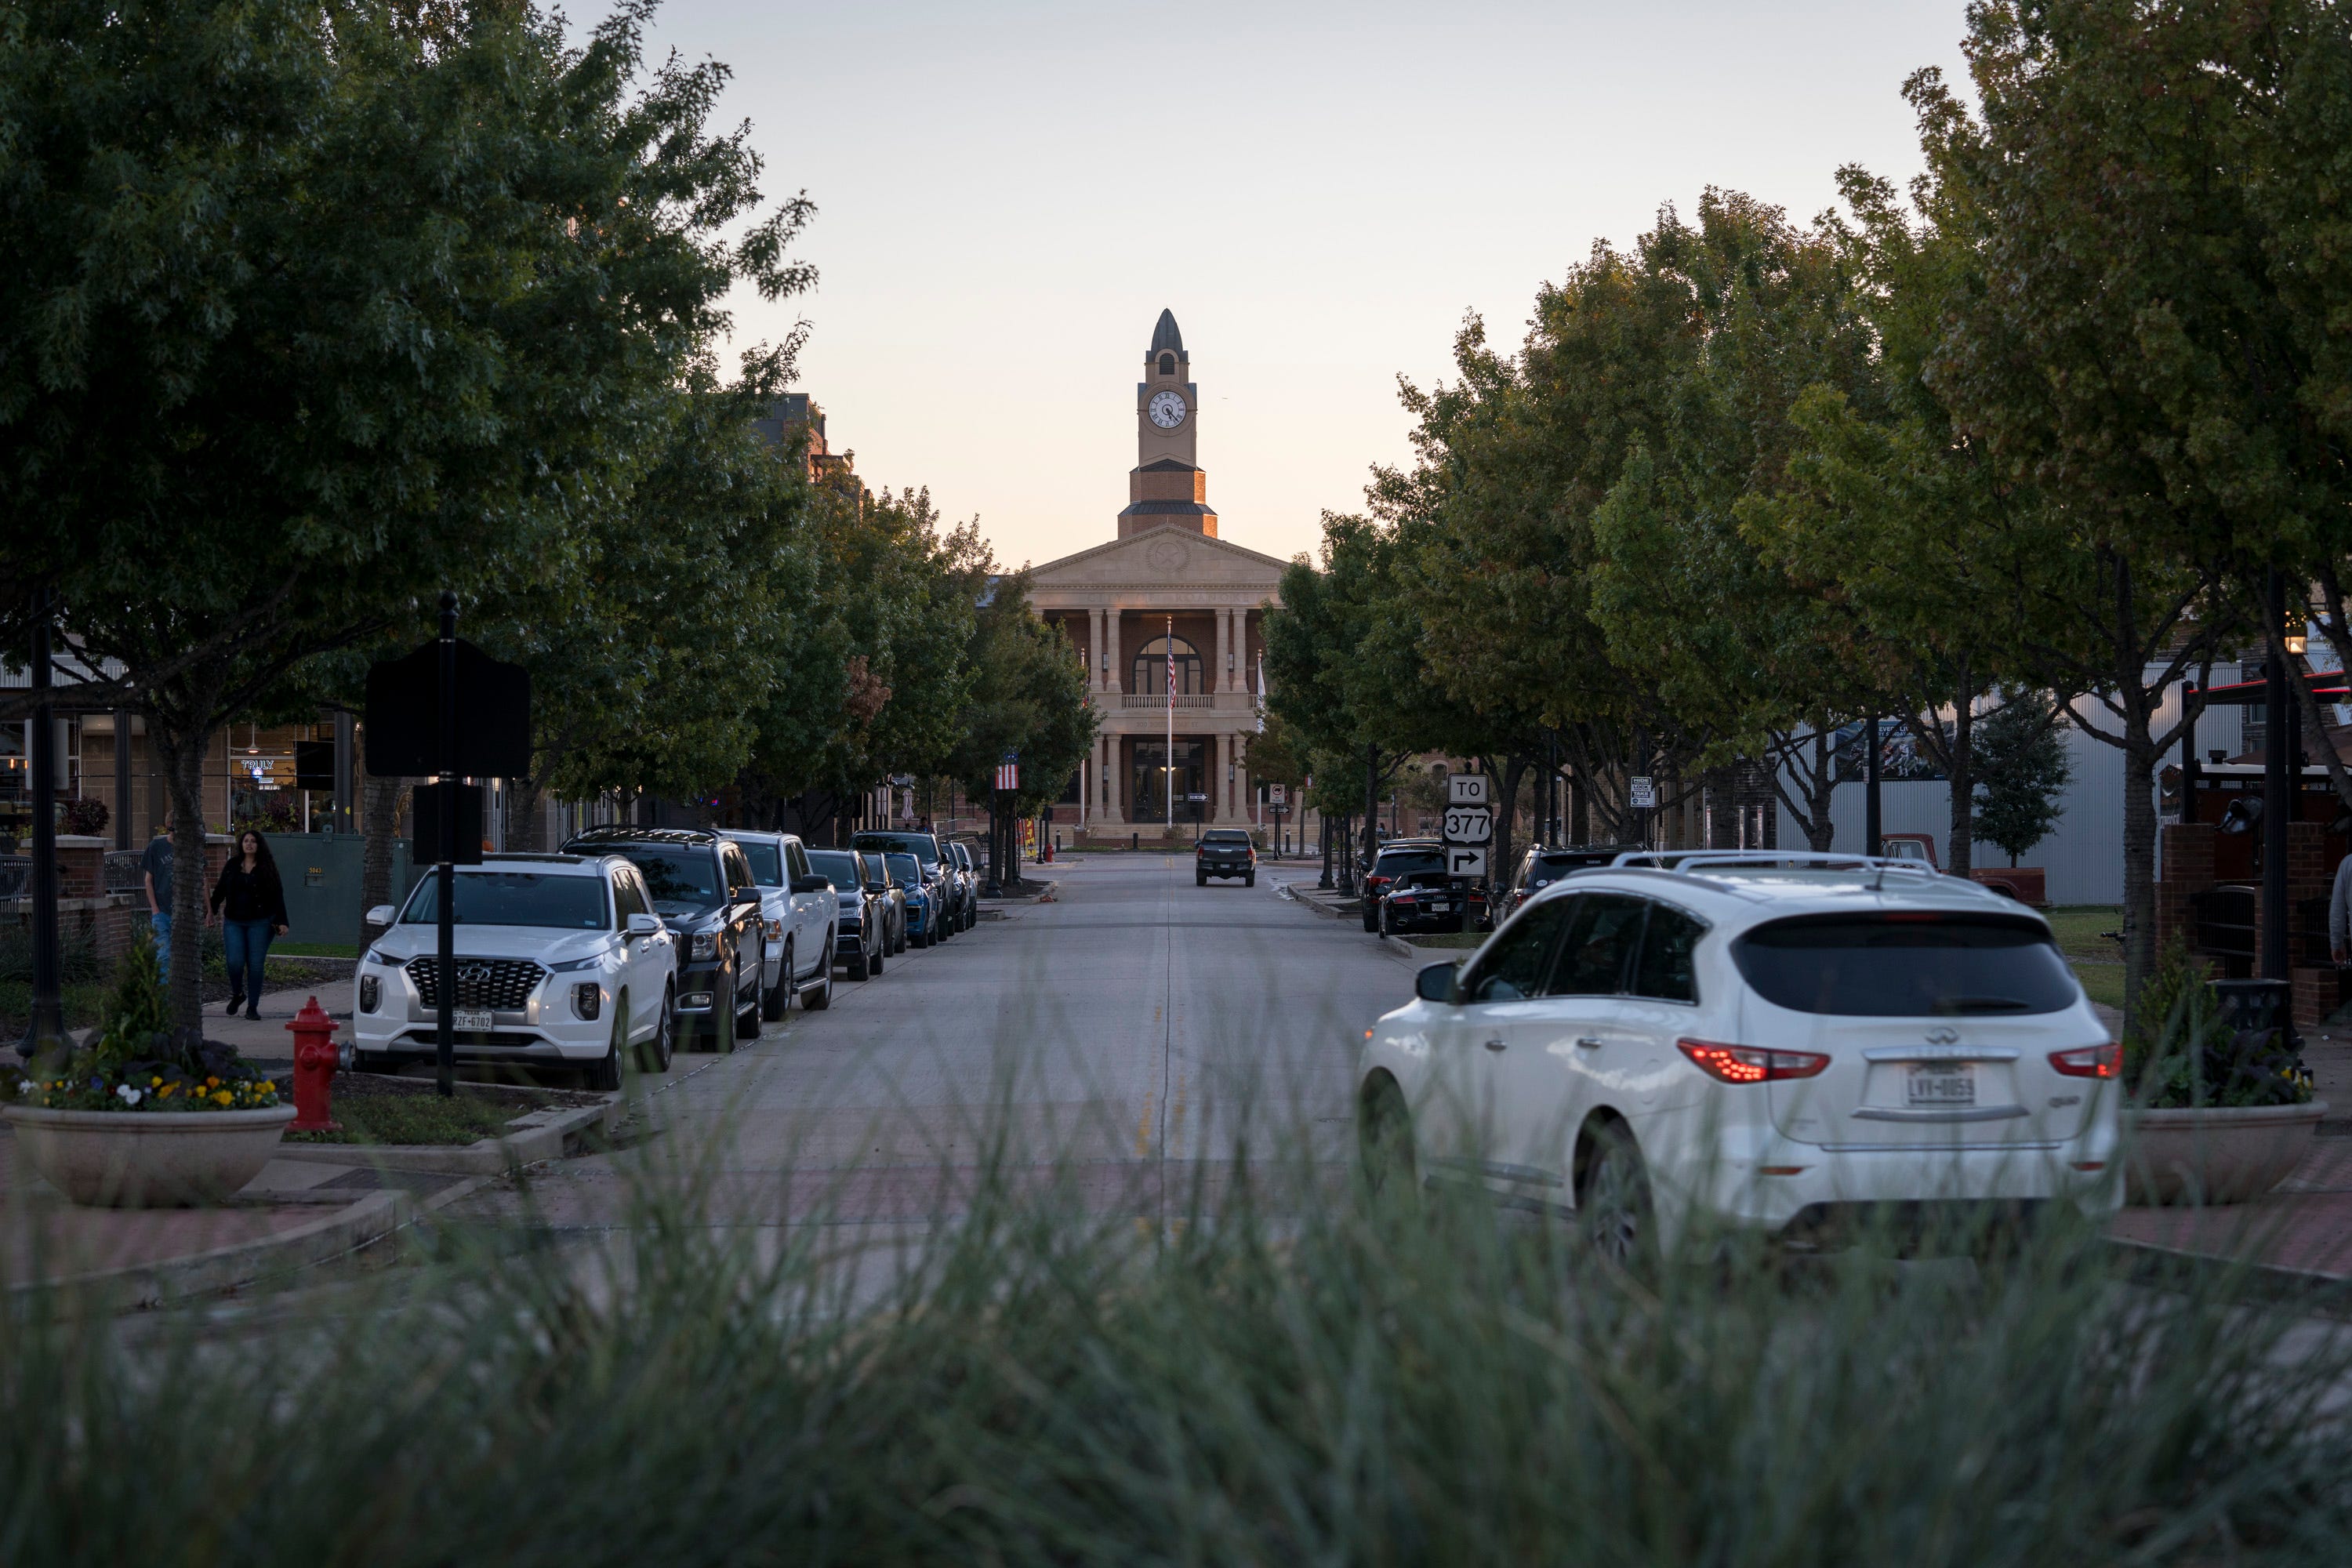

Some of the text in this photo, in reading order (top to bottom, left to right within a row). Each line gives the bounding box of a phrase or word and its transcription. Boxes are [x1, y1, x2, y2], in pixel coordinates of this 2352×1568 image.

[1087, 593, 1249, 602] CITY OF ROANOKE
[1457, 782, 1480, 797] TO
[1447, 815, 1488, 835] 377
